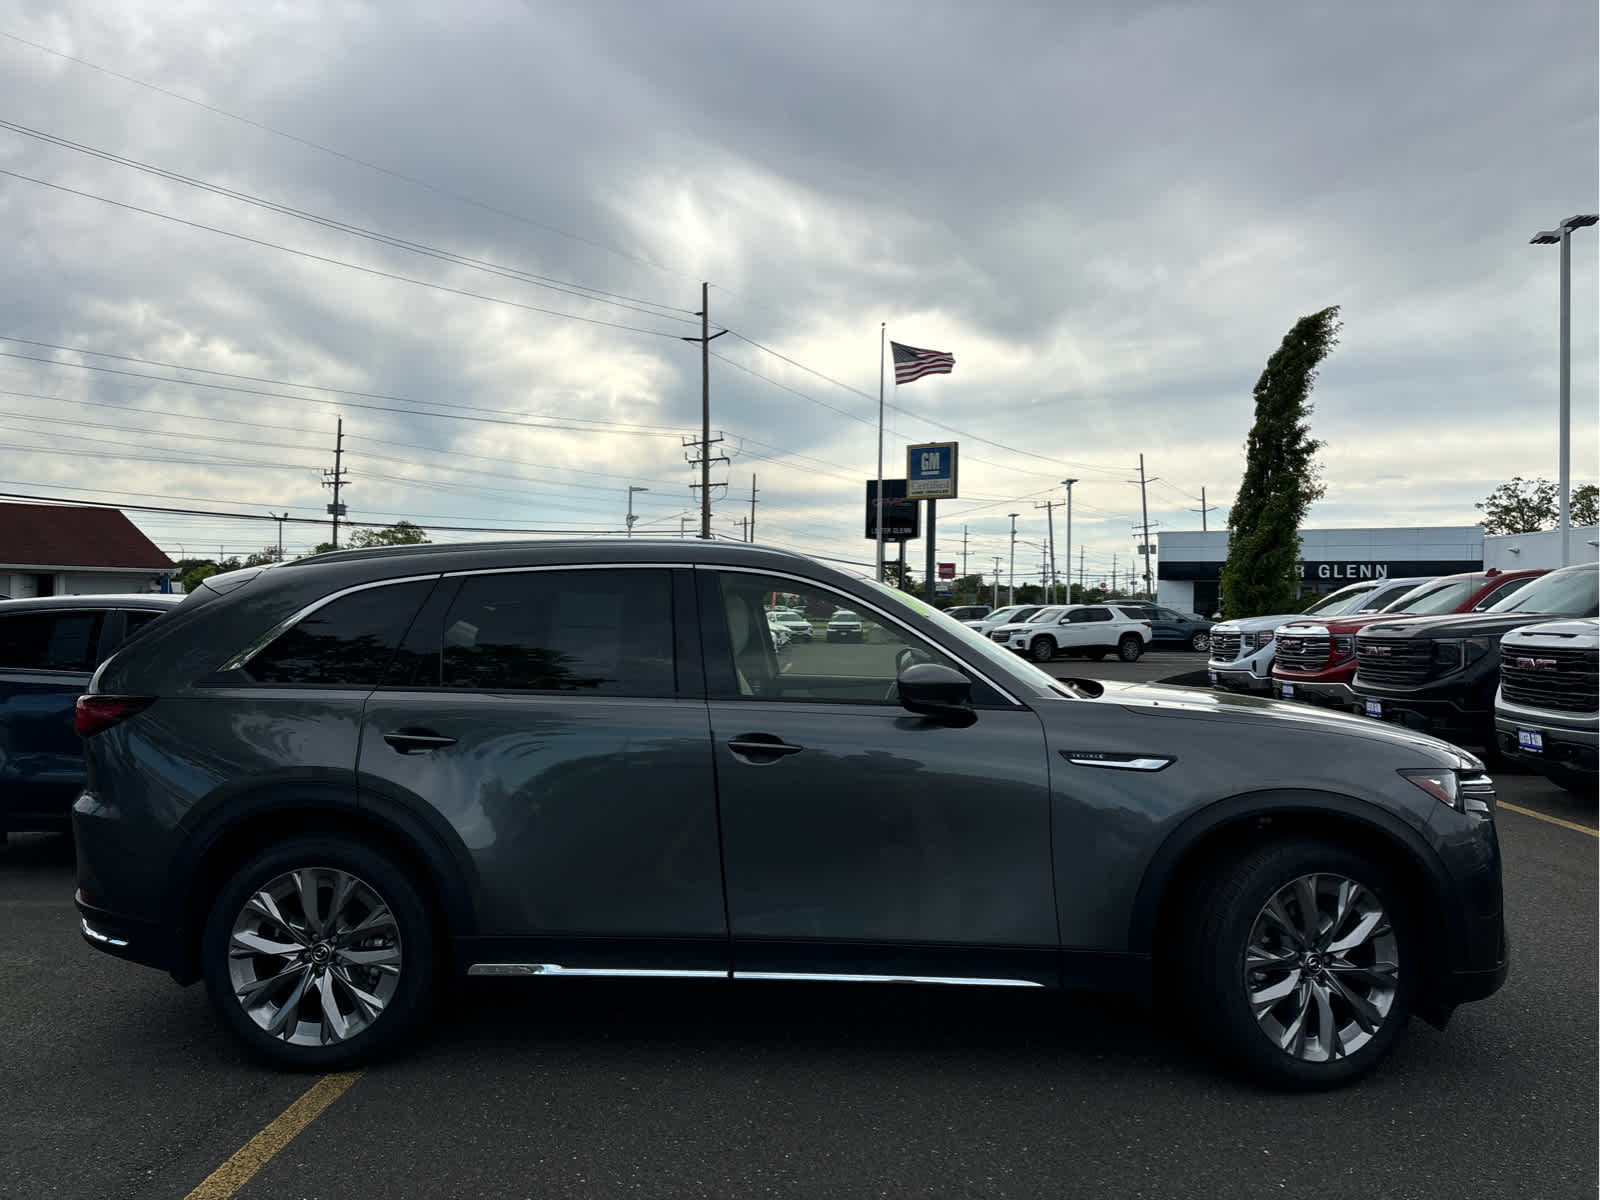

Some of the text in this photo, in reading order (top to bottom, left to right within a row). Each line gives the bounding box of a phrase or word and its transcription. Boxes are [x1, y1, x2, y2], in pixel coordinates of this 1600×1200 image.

[921, 452, 940, 471] GM
[1318, 564, 1388, 578] GLENN
[1515, 657, 1557, 672] GMC
